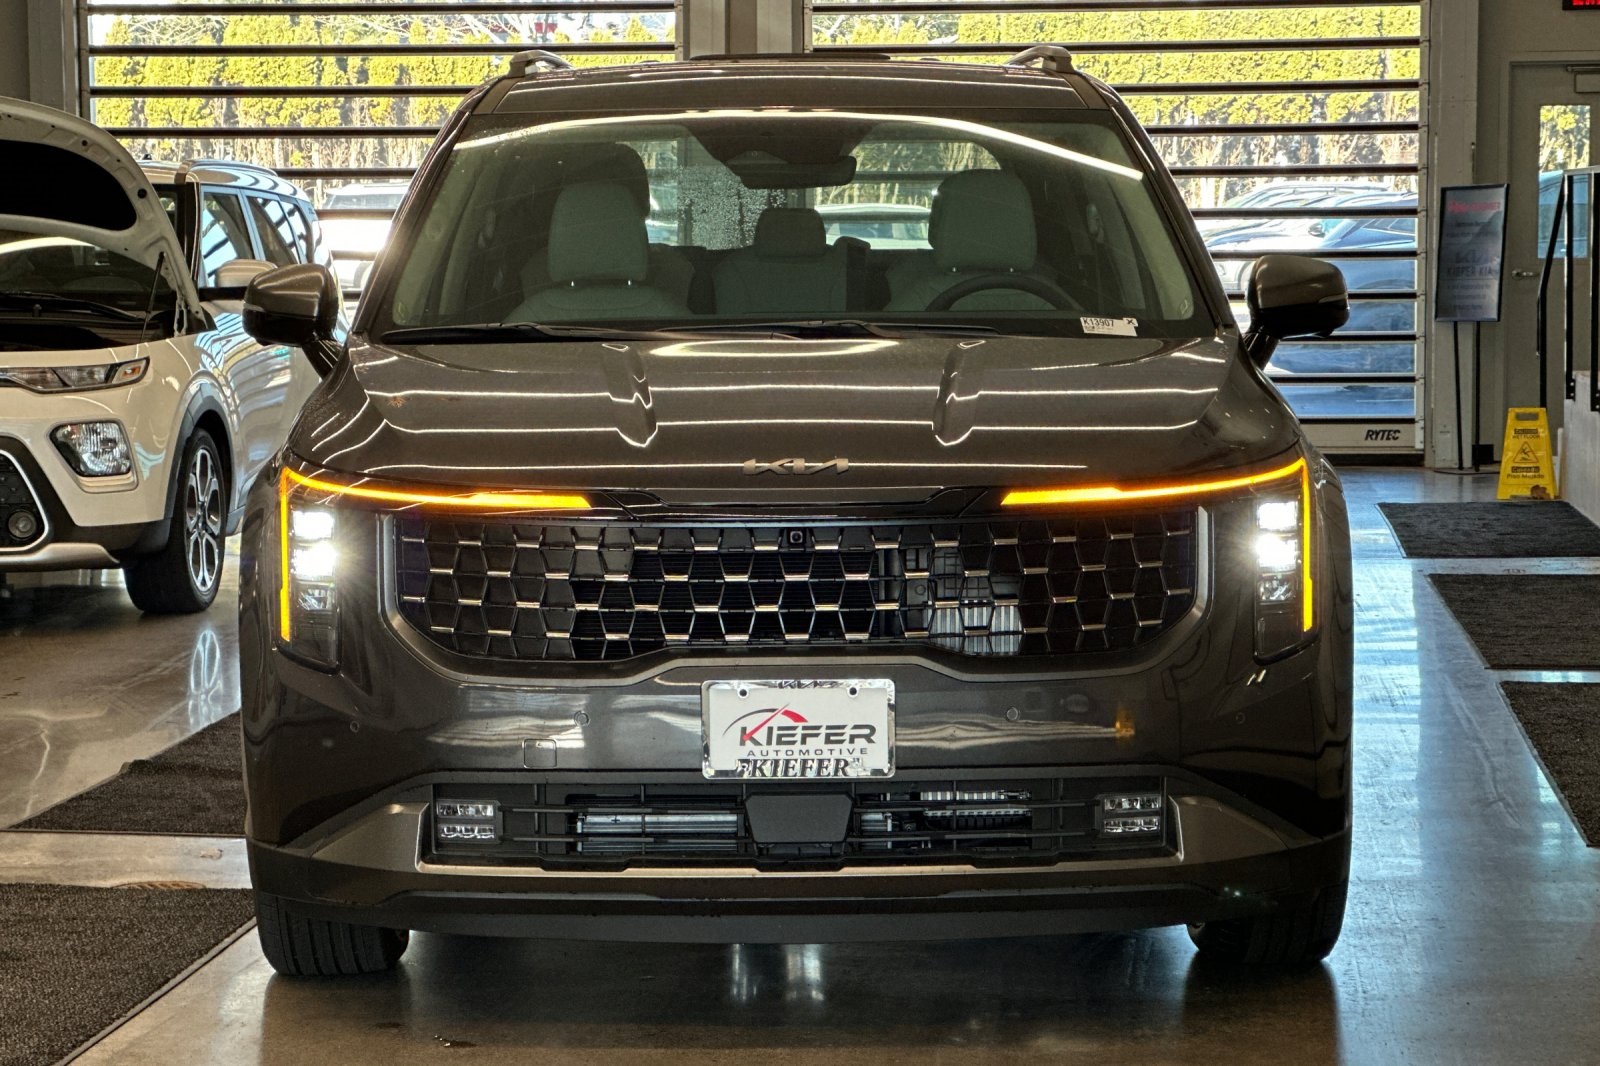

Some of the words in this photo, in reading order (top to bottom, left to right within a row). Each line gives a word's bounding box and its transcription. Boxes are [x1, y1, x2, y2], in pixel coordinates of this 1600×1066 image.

[1364, 429, 1401, 441] RYTEC
[743, 458, 849, 475] KIA
[739, 724, 876, 746] KIEFER
[747, 748, 868, 757] AUTOMOTIVE
